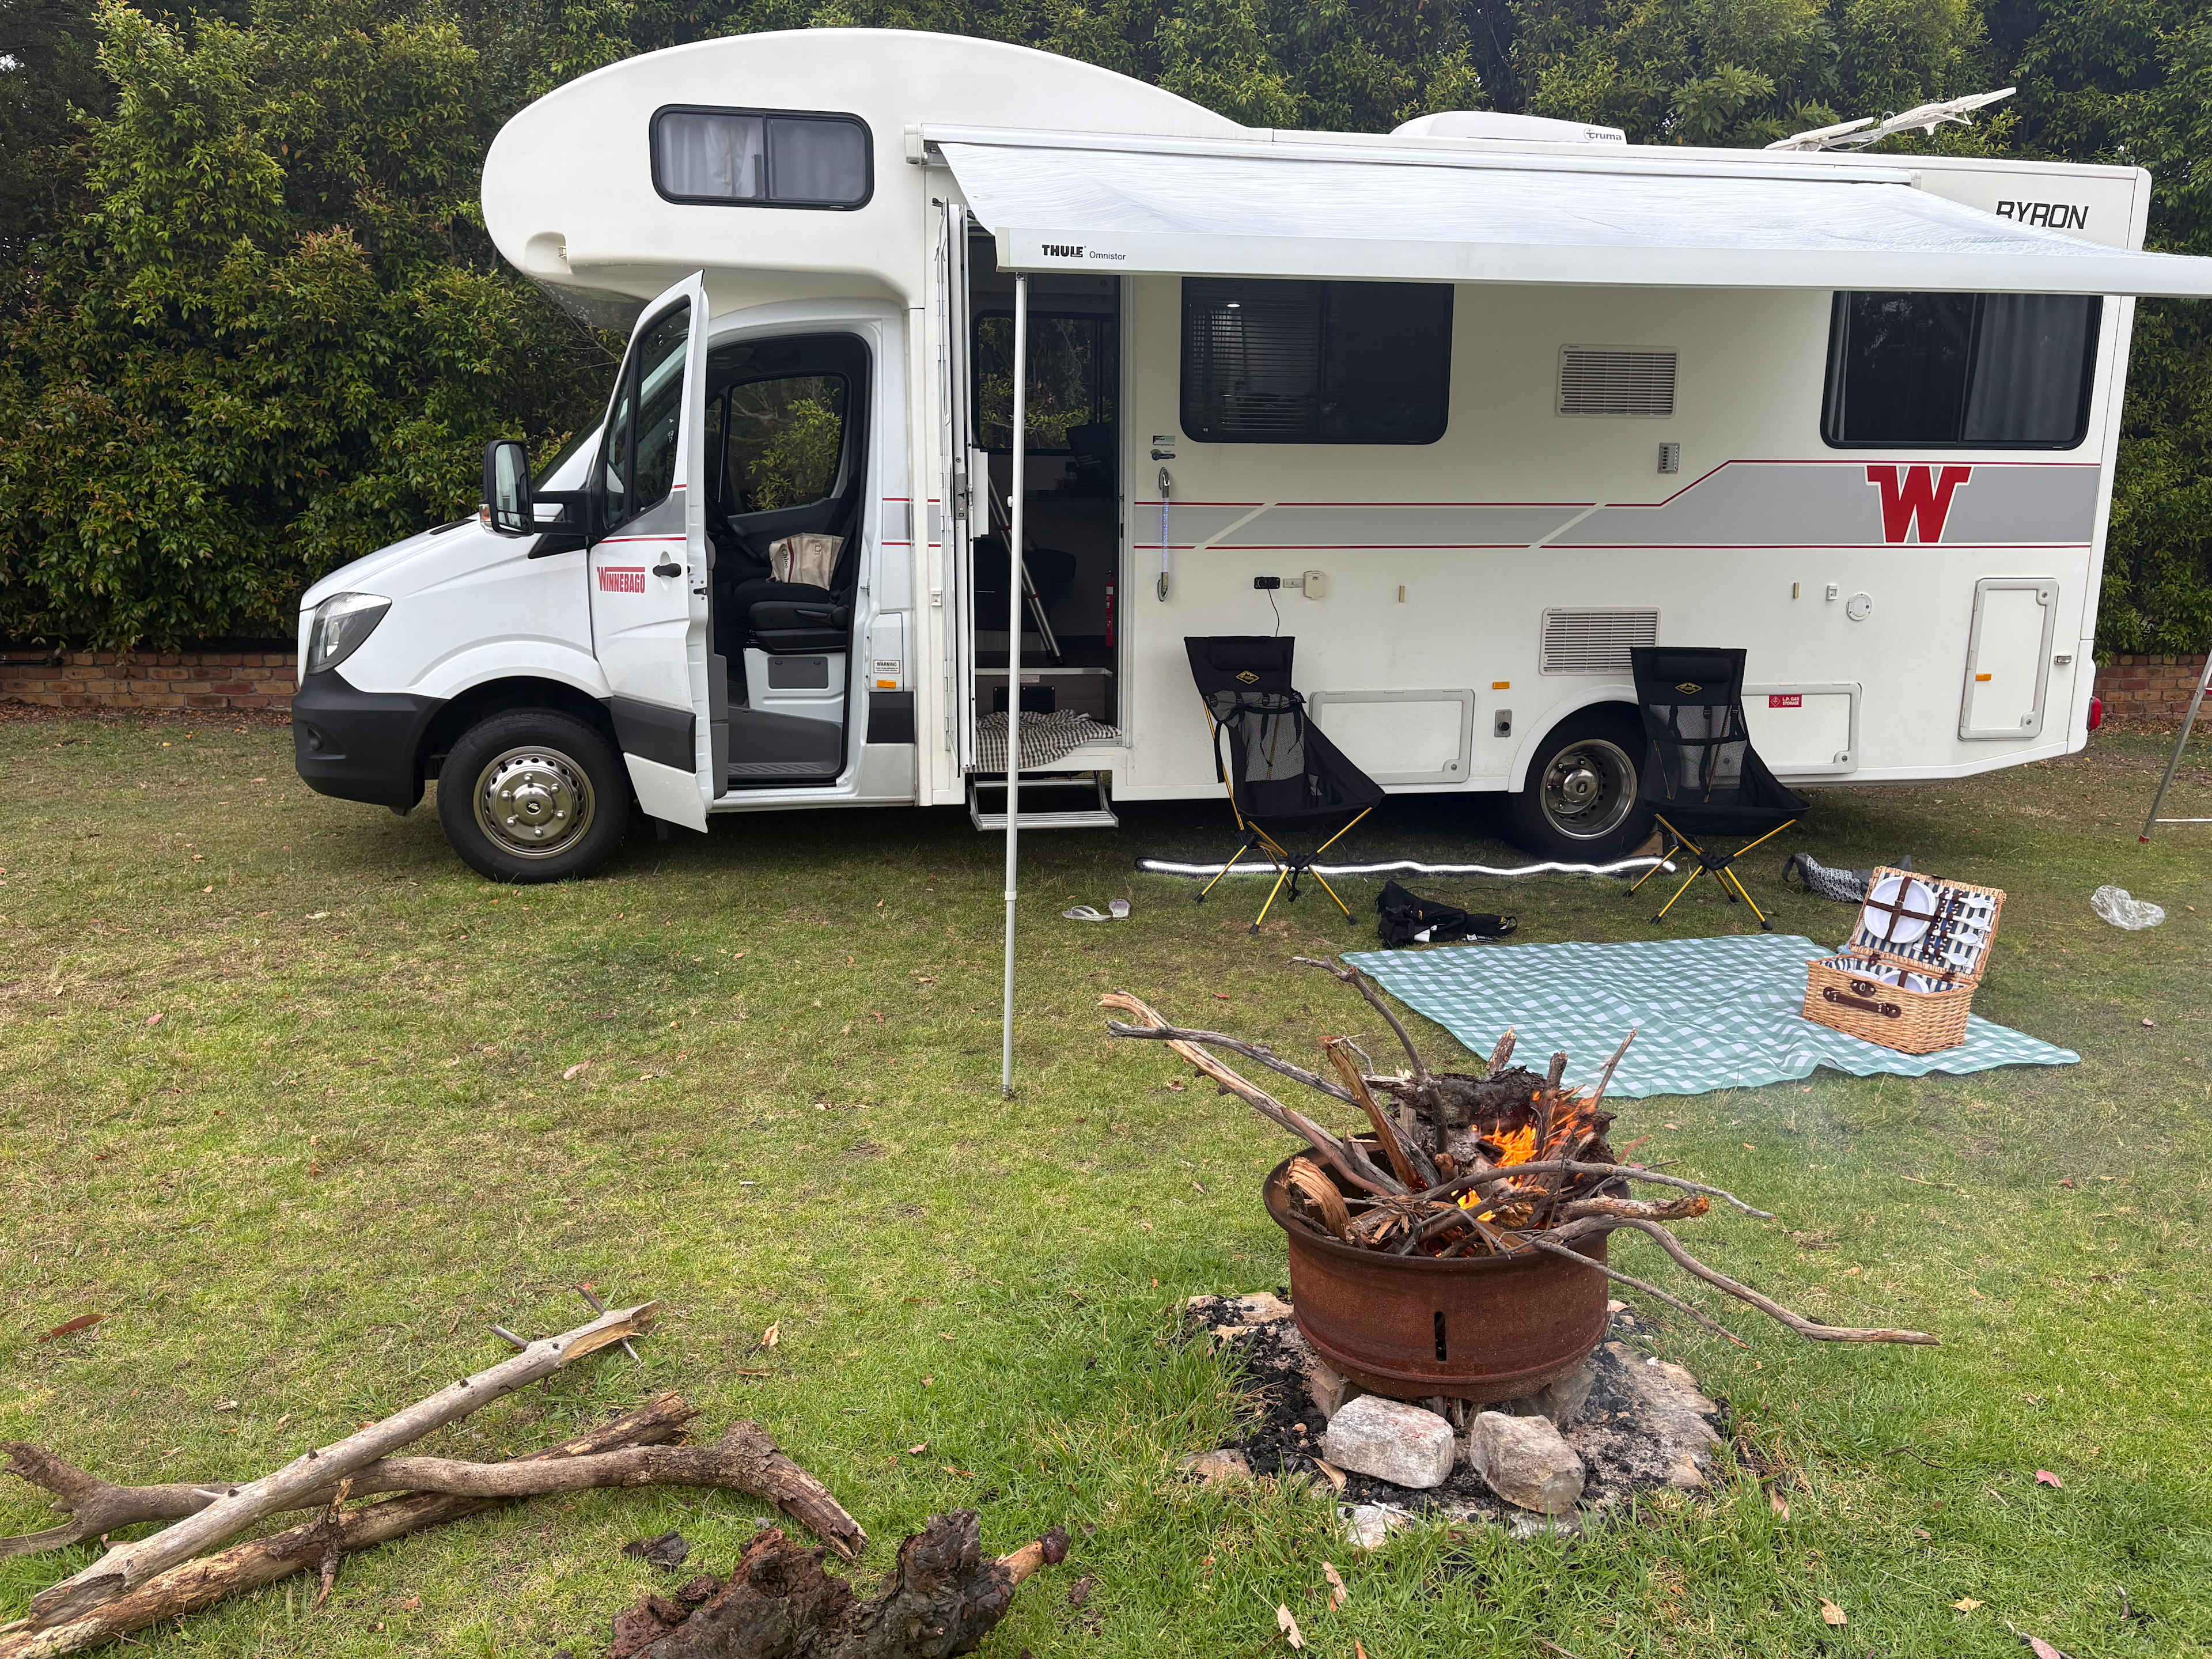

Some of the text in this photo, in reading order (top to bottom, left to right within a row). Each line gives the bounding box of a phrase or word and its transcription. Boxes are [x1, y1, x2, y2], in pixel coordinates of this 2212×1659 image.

[1584, 128, 1622, 140] truma
[1041, 244, 1126, 260] THULE Omnistor
[1866, 465, 1972, 543] W
[596, 566, 645, 593] WINNEBAGO
